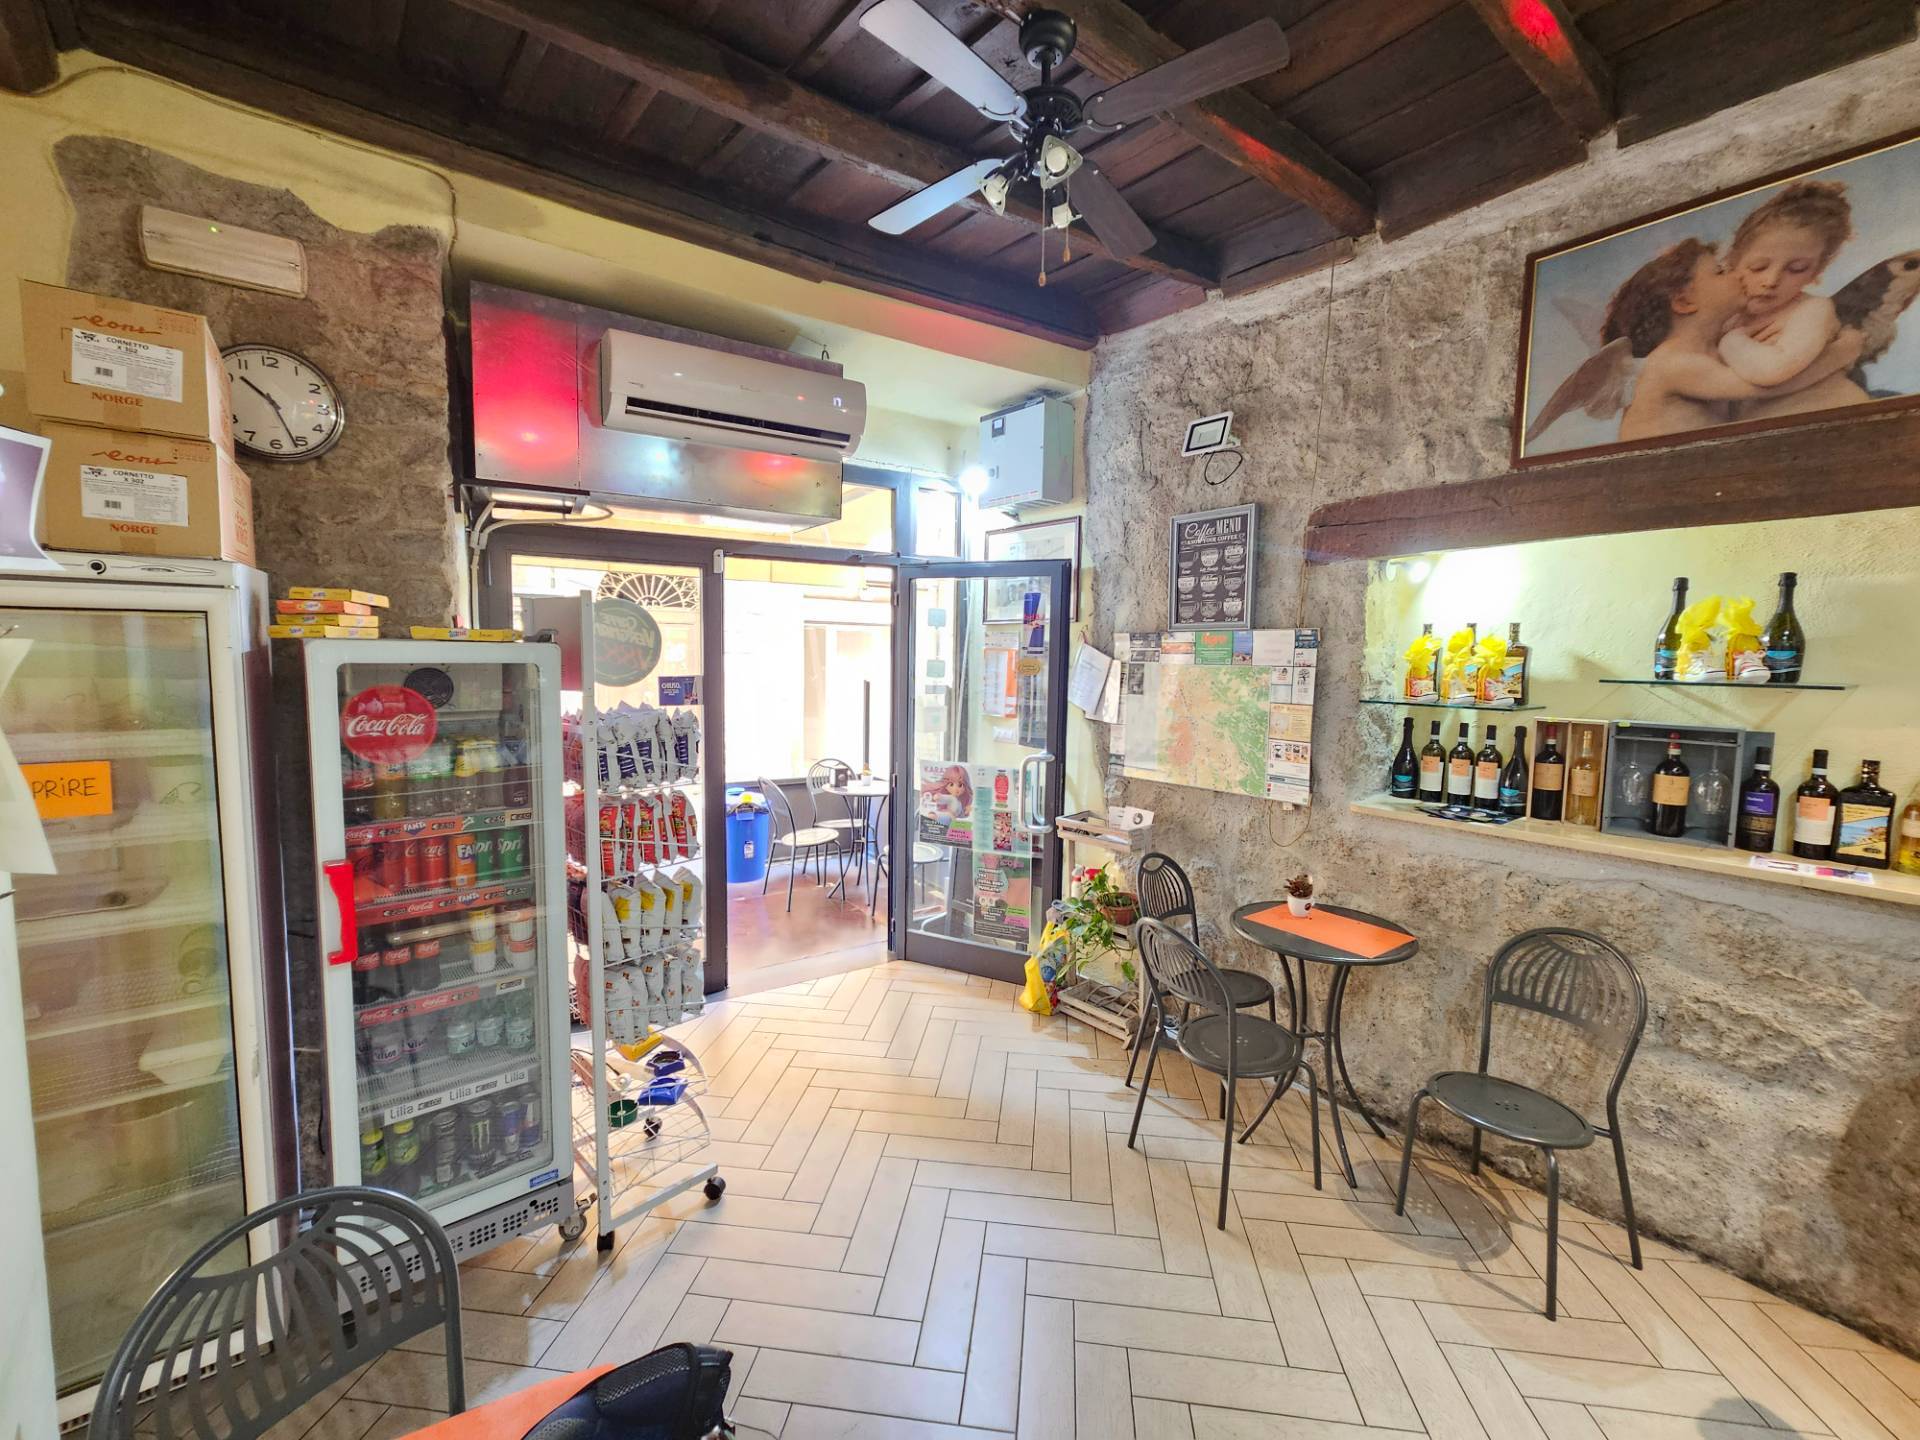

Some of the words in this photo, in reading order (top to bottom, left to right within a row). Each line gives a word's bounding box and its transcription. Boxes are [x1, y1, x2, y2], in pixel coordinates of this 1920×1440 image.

[238, 358, 248, 370] 11
[261, 355, 279, 369] 12
[294, 366, 299, 376] 1
[308, 383, 322, 395] 2
[91, 391, 145, 407] NORGE
[317, 404, 330, 416] 3
[312, 423, 325, 434] 4
[243, 430, 256, 442] 7
[295, 436, 309, 447] 5
[269, 439, 283, 450] 6
[112, 470, 154, 480] CORNETTO
[110, 523, 159, 535] NORGE
[1184, 522, 1216, 544] Coffee
[1216, 516, 1242, 535] MENU
[346, 713, 429, 738] Coca-Cola
[504, 1070, 526, 1084] Lilia
[449, 1088, 471, 1102] Lilia
[389, 1104, 414, 1120] Lilia
